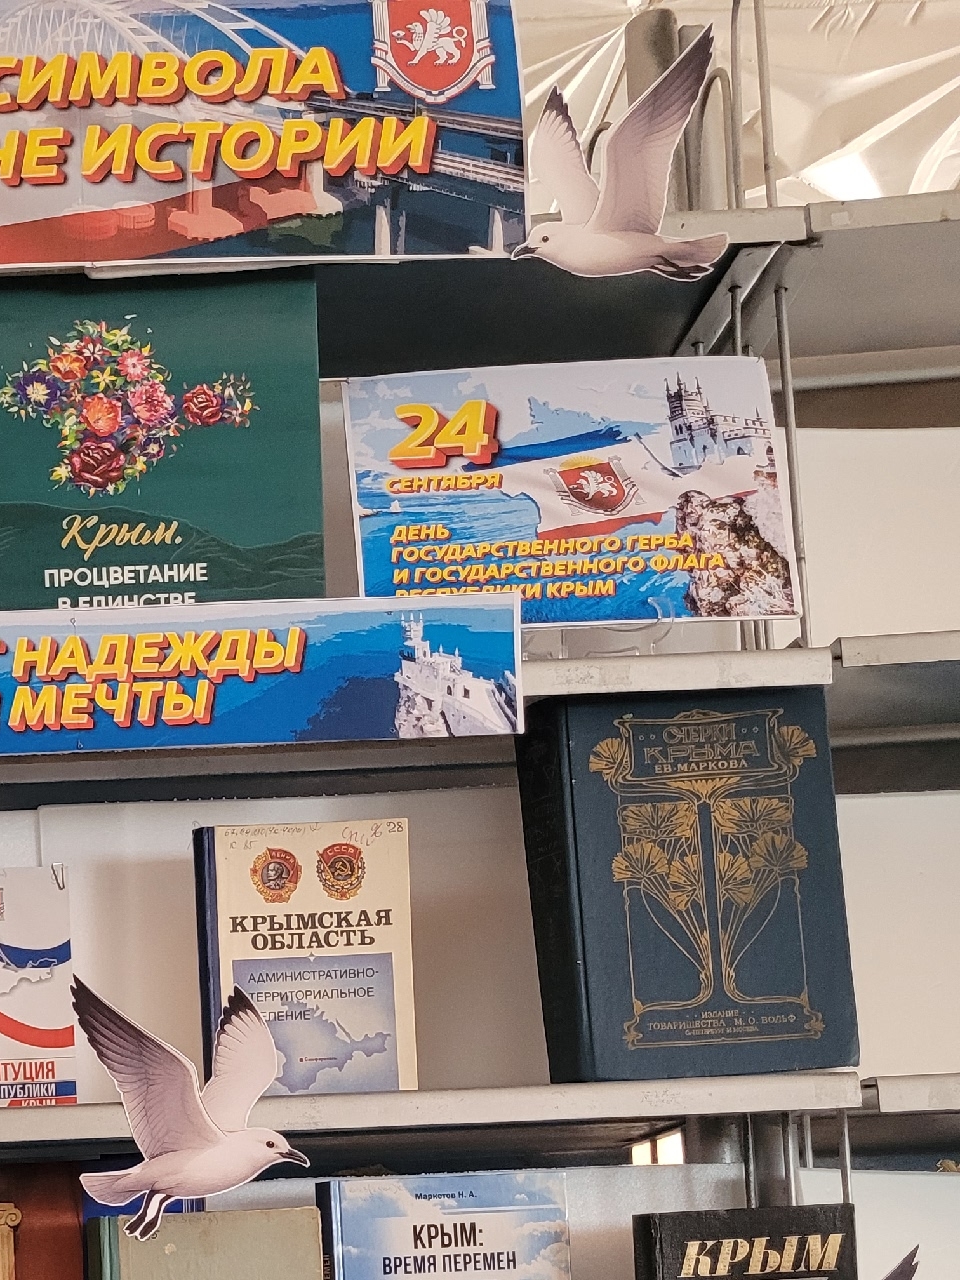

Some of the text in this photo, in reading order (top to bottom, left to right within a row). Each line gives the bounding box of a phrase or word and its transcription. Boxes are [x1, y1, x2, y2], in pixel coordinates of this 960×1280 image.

[81, 116, 437, 183] ИСТОРИИ
[388, 398, 500, 469] 24
[386, 473, 502, 494] СЕНТЯБРЯ
[60, 513, 183, 562] Крым.
[390, 524, 452, 546] ДЕНЬ
[391, 532, 695, 564] ГОСУДАРСТВЕННОГО ГЕРБА
[44, 562, 208, 588] ПРОЦВЕТАНИЕ
[393, 552, 728, 585] И ГОСУДАРСТВЕННОГО ФЛАГА
[546, 579, 617, 600] КРЫМ
[11, 626, 307, 684] НАДЕЖДЫ
[8, 678, 214, 731] МЕЧТЫ
[663, 723, 736, 743] ОЧЕРКИ
[643, 740, 760, 764] КРЫМА
[229, 908, 393, 933] КРЫМСКАЯ
[251, 929, 376, 951] ОБЛАСТЬ
[247, 967, 379, 984] АДМИНИСТРАТИВНО-
[248, 987, 375, 1002] ТЕРРИТОРИАЛЬНОЕ
[413, 1222, 484, 1249] КРЫМ:
[382, 1251, 517, 1275] ВРЕМЯ ПЕРЕМЕН
[677, 1233, 846, 1278] КРЫМ
